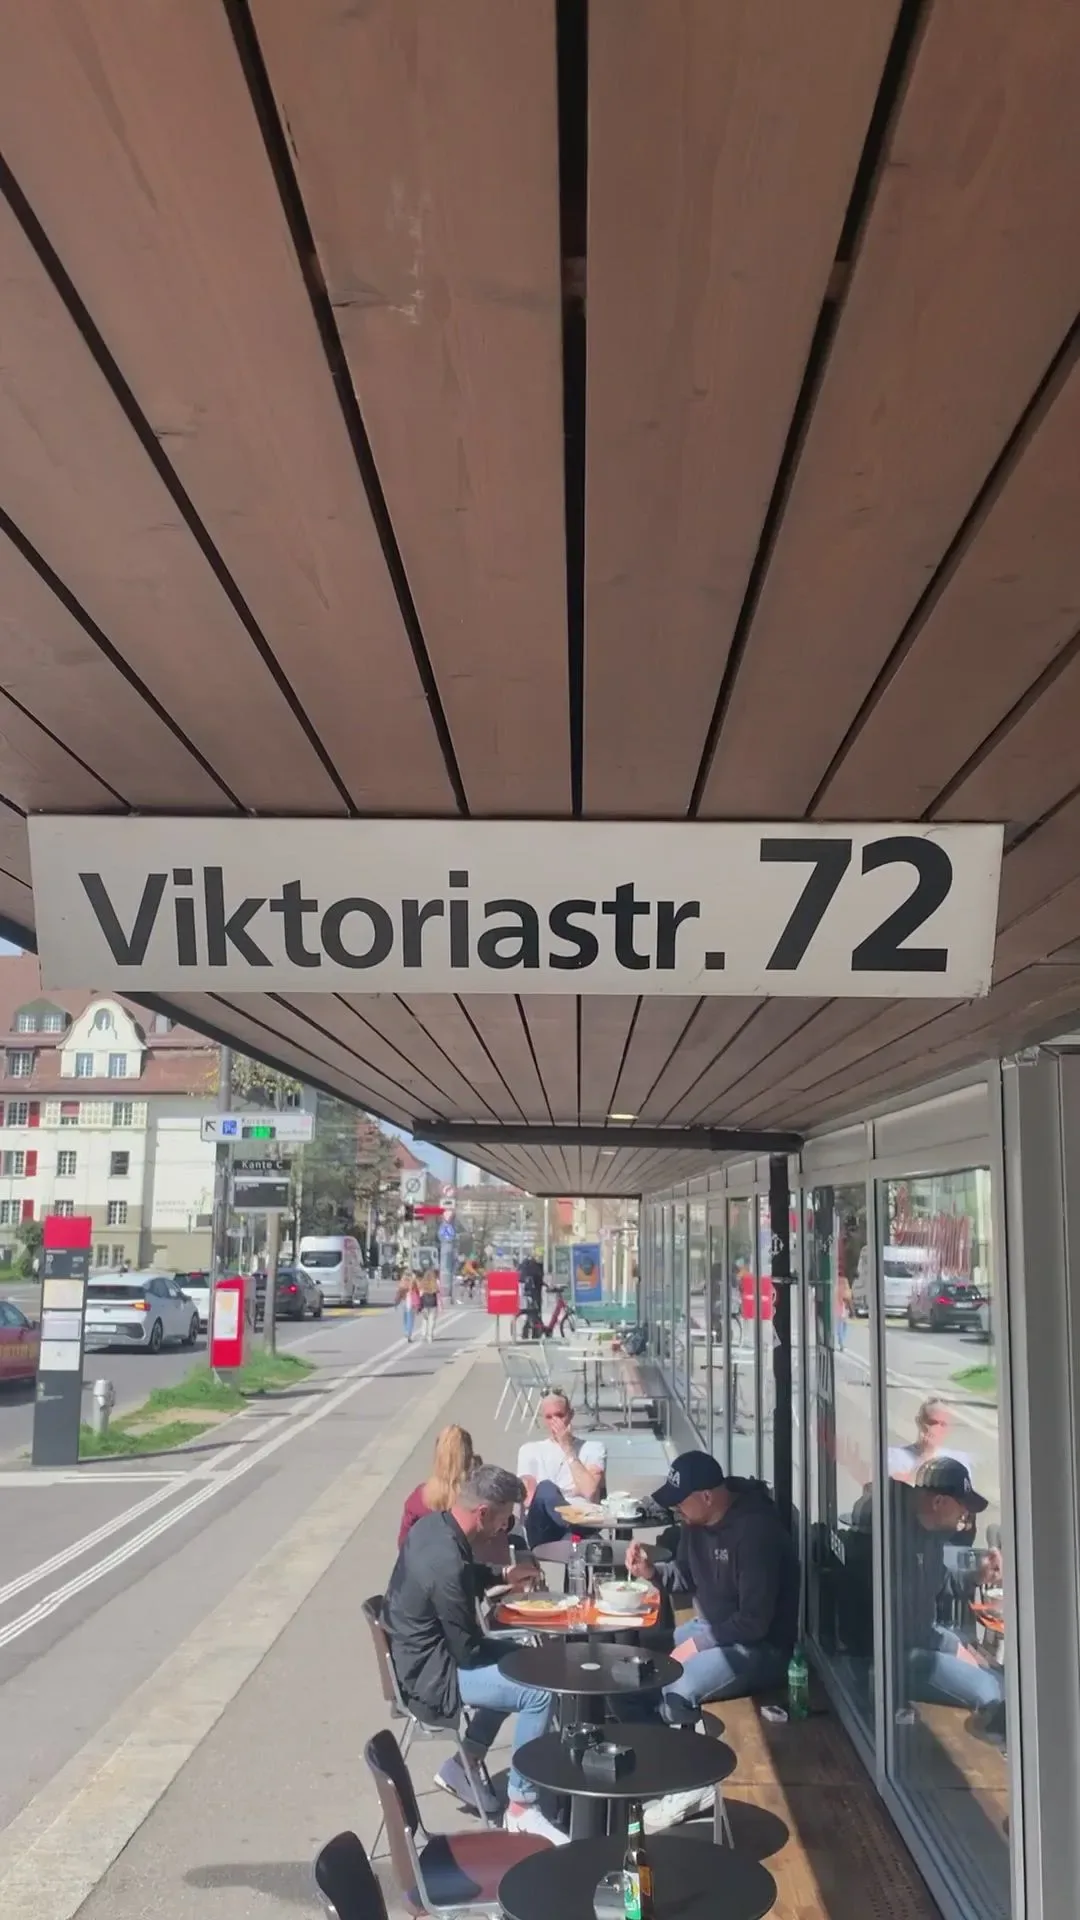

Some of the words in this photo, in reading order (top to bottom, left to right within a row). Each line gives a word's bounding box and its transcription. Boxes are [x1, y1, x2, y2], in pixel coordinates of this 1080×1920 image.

[79, 866, 726, 972] Viktoriastr.
[760, 836, 953, 973] 72
[241, 1161, 273, 1170] Kante
[275, 1161, 285, 1170] C
